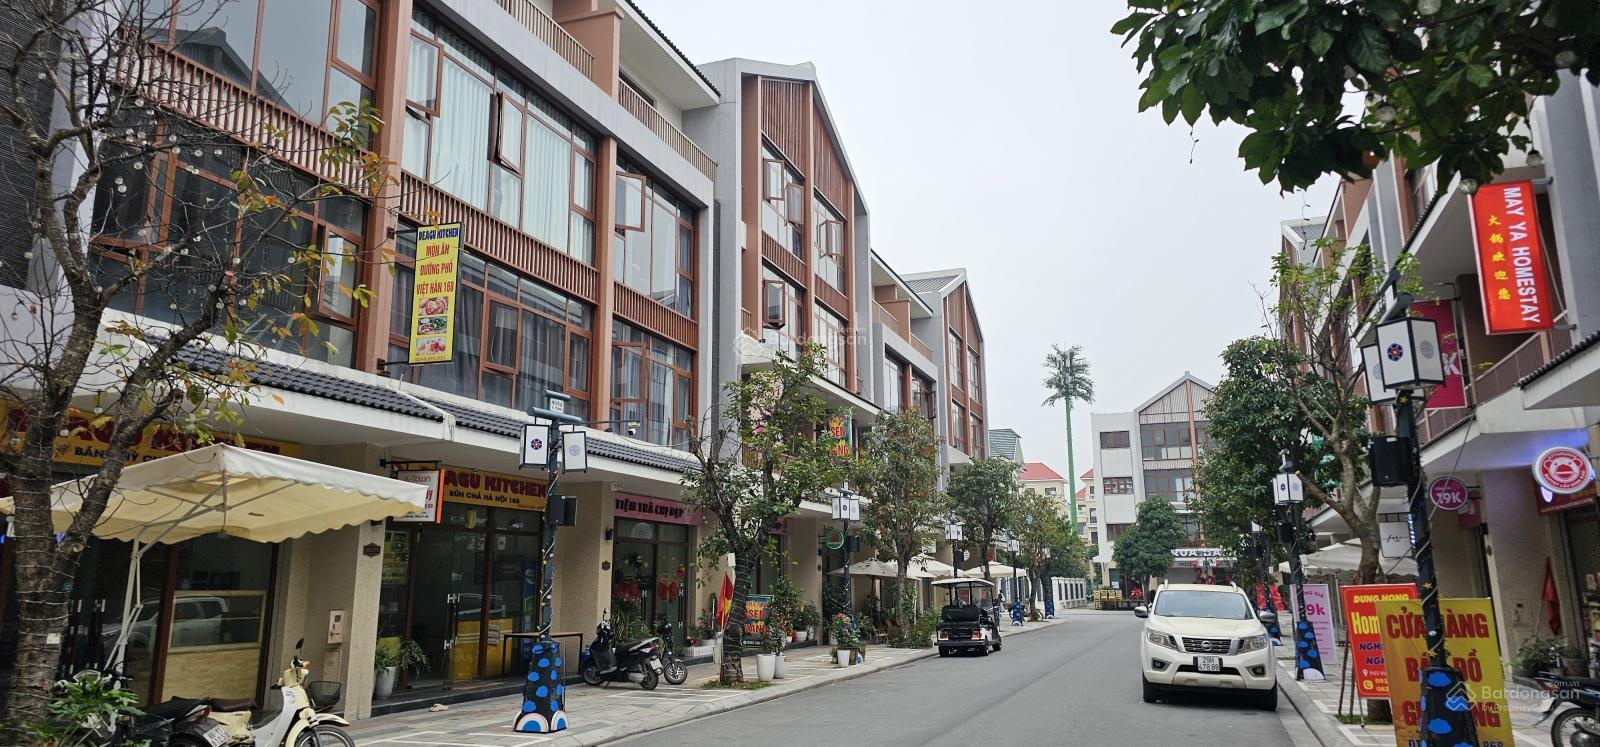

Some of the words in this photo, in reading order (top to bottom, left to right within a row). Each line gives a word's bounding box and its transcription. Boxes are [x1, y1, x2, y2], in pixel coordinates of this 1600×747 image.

[1503, 187, 1525, 216] MAY
[1508, 221, 1528, 241] YA
[1511, 246, 1541, 323] HOMESTAY
[74, 446, 104, 457] BÁN
[484, 474, 547, 498] KITCHEN
[1306, 603, 1326, 616] 9k
[1444, 608, 1490, 639] ÀNG
